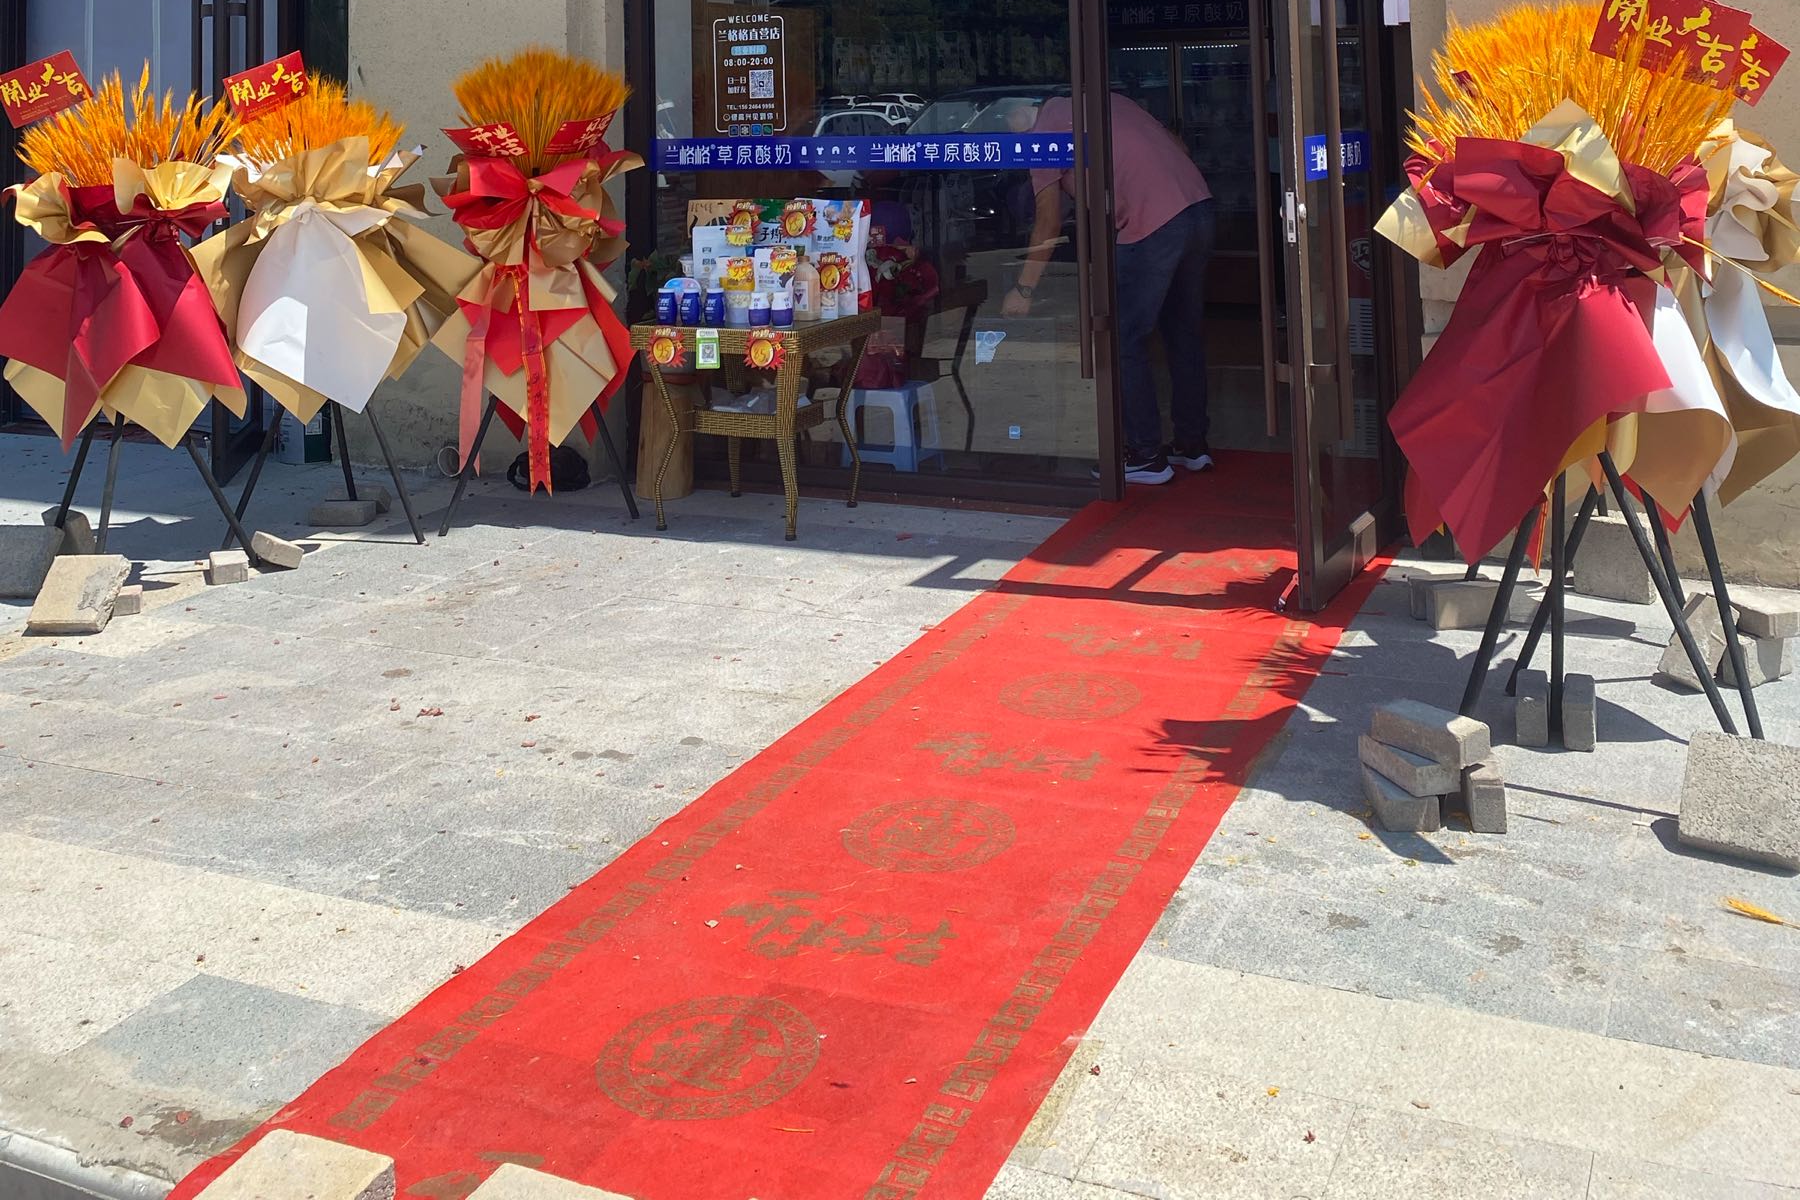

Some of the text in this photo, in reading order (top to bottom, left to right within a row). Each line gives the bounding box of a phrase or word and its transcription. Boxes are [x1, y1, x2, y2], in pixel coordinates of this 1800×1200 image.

[727, 13, 769, 24] WELCOME
[718, 27, 780, 42] 兰格格直营店
[723, 56, 774, 67] 08:00-20:00
[716, 144, 792, 165] 草原酸奶
[923, 141, 1001, 162] 草原酸奶
